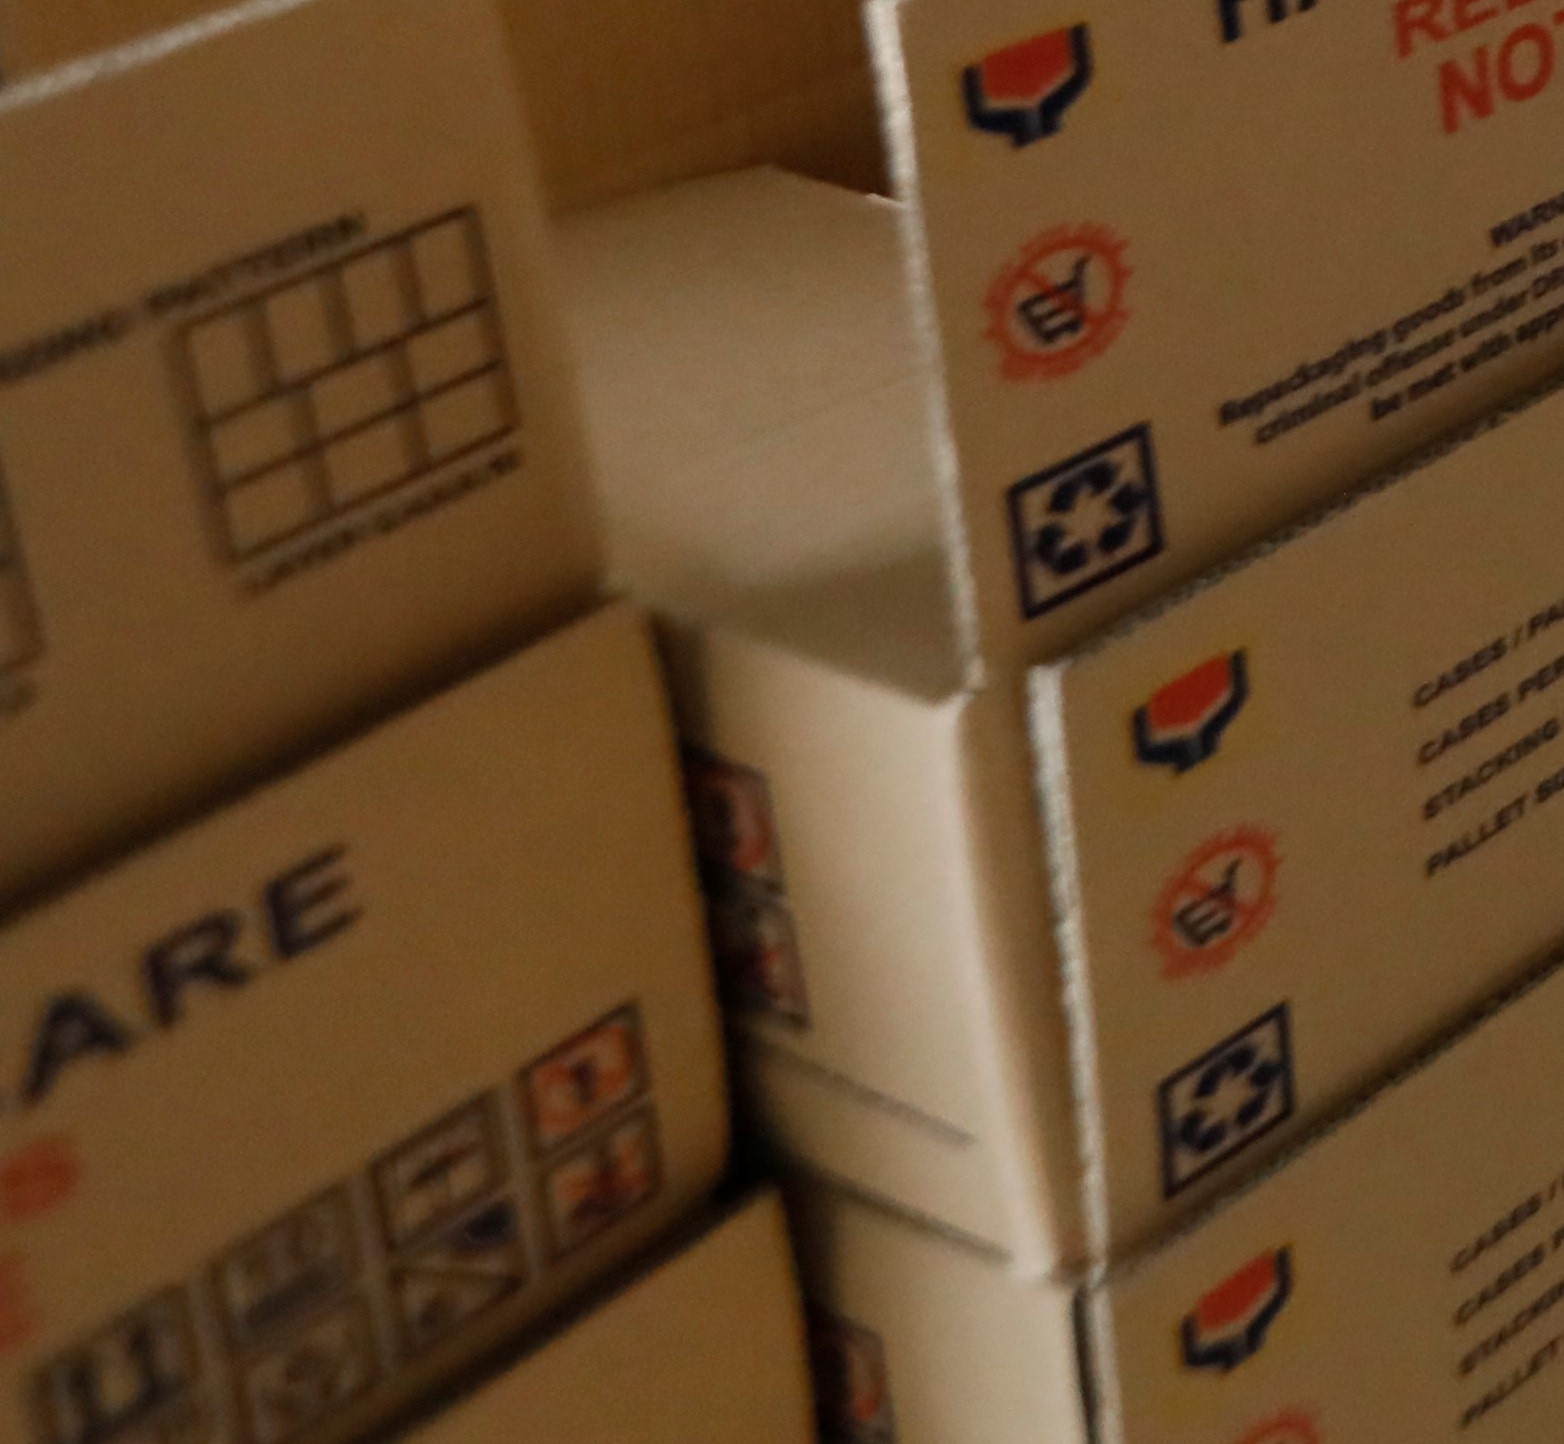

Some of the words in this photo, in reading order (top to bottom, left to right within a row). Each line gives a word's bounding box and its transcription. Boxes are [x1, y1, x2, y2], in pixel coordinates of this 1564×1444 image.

[1413, 637, 1508, 709] CASES
[1418, 693, 1510, 767] CASES
[1423, 718, 1560, 820] STACKING
[1425, 792, 1530, 879] PALLET
[23, 841, 363, 1107] ARE
[1451, 1197, 1544, 1275] CASES
[1455, 1249, 1547, 1328] CASES
[1460, 1336, 1562, 1431] PALLET
